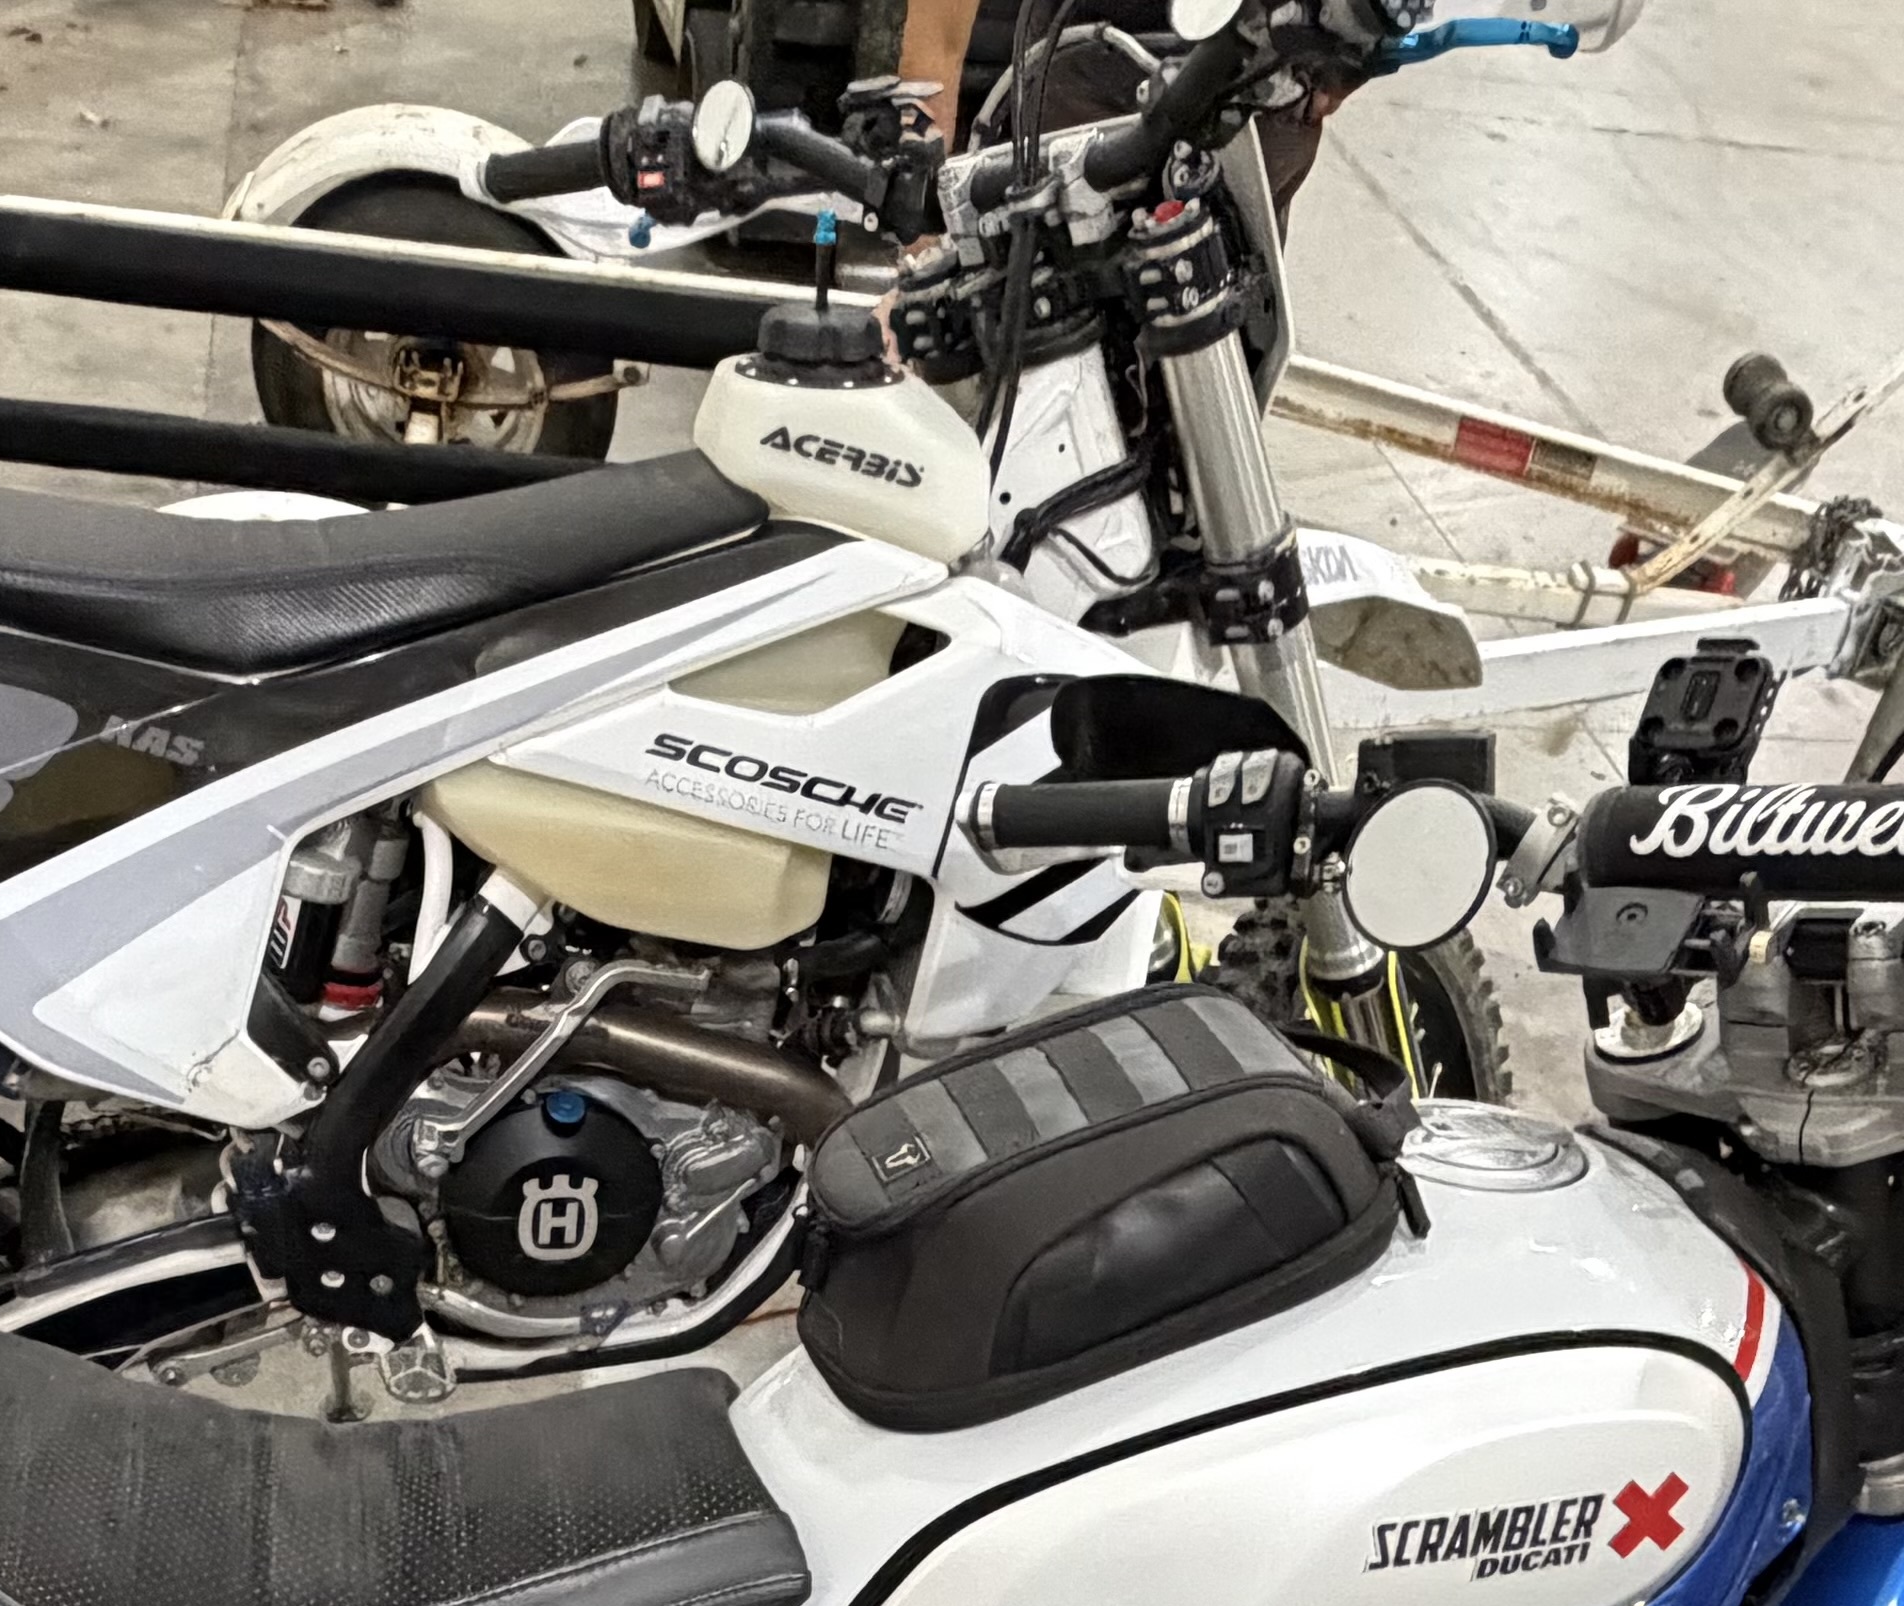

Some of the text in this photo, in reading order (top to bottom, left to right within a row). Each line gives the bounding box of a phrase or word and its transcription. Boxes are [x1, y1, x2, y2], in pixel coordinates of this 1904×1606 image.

[760, 425, 925, 490] ACERBIS
[645, 732, 918, 824] SCOSCHE
[645, 768, 890, 849] ACCESSORIES FOR LIFE
[1366, 1494, 1605, 1570] SCRAMBLER
[1475, 1542, 1591, 1580] DUCATI
